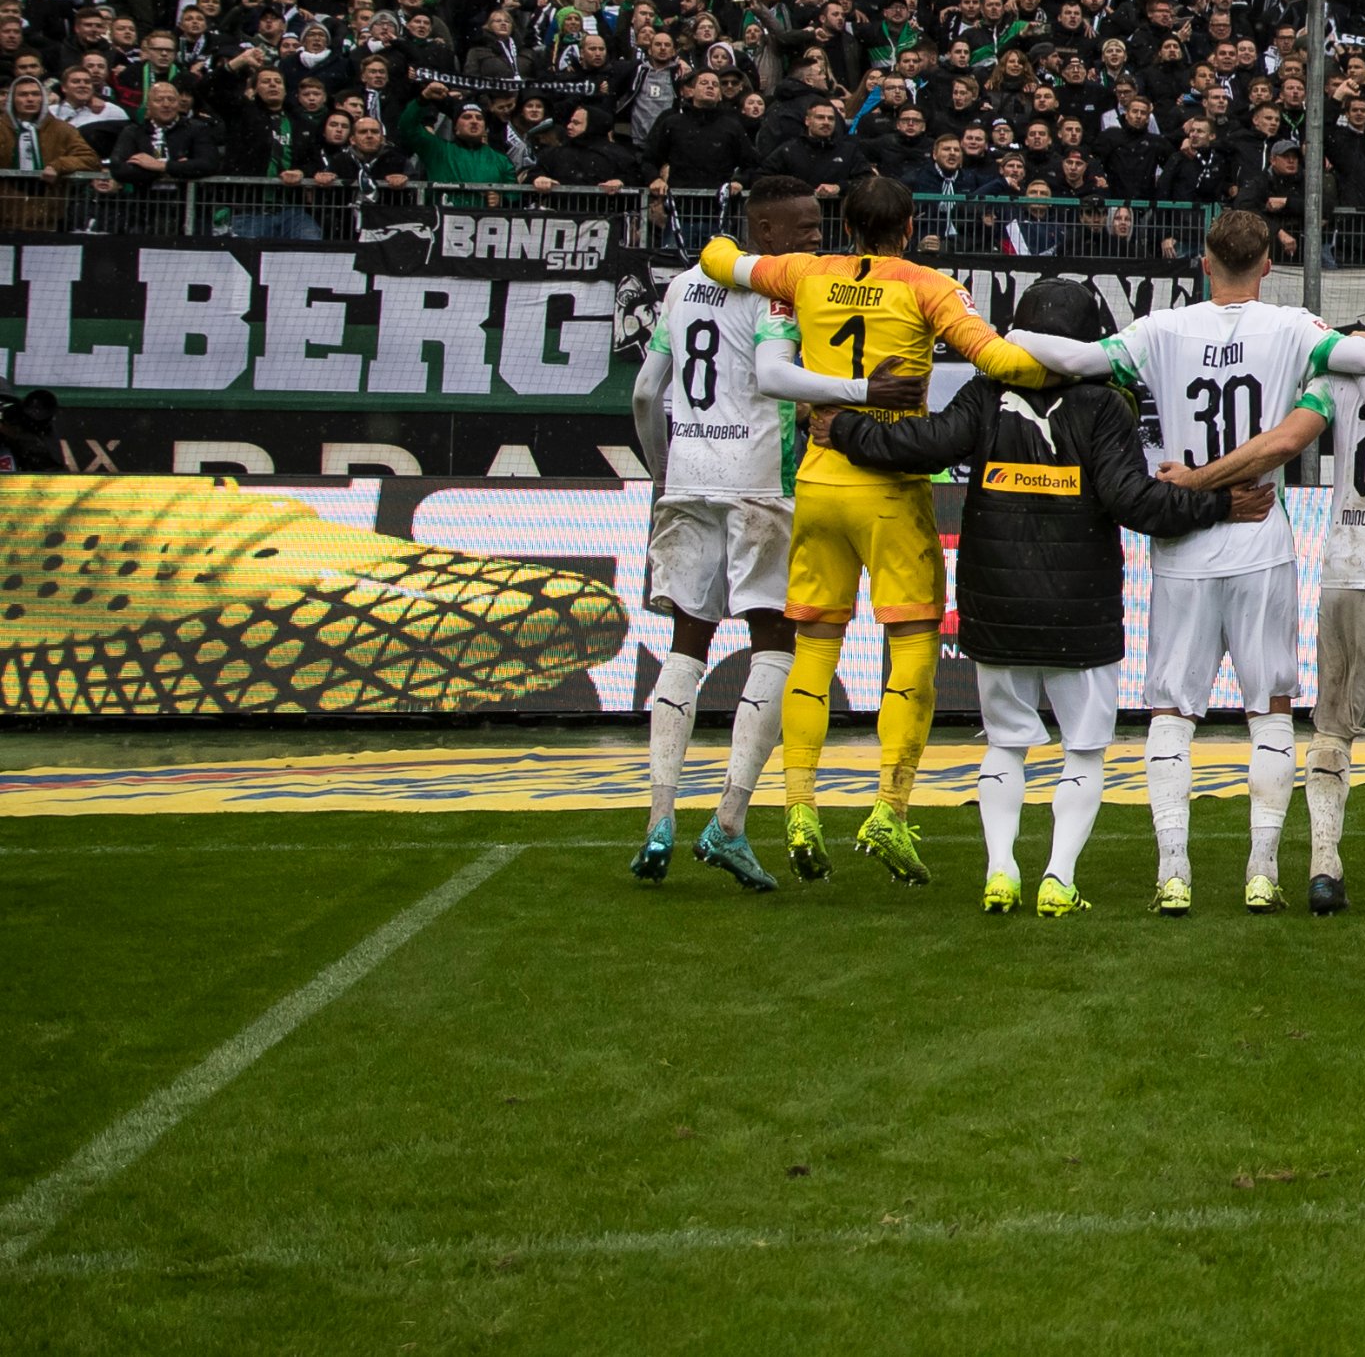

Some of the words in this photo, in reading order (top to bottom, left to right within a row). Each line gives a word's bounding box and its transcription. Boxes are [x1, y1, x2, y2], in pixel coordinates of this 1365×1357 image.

[441, 213, 612, 261] BANDA
[545, 250, 600, 272] SUD
[0, 244, 614, 397] LBERG
[829, 314, 866, 380] 1
[682, 318, 720, 412] 8
[1184, 373, 1263, 469] 30
[1014, 472, 1078, 489] Postbank
